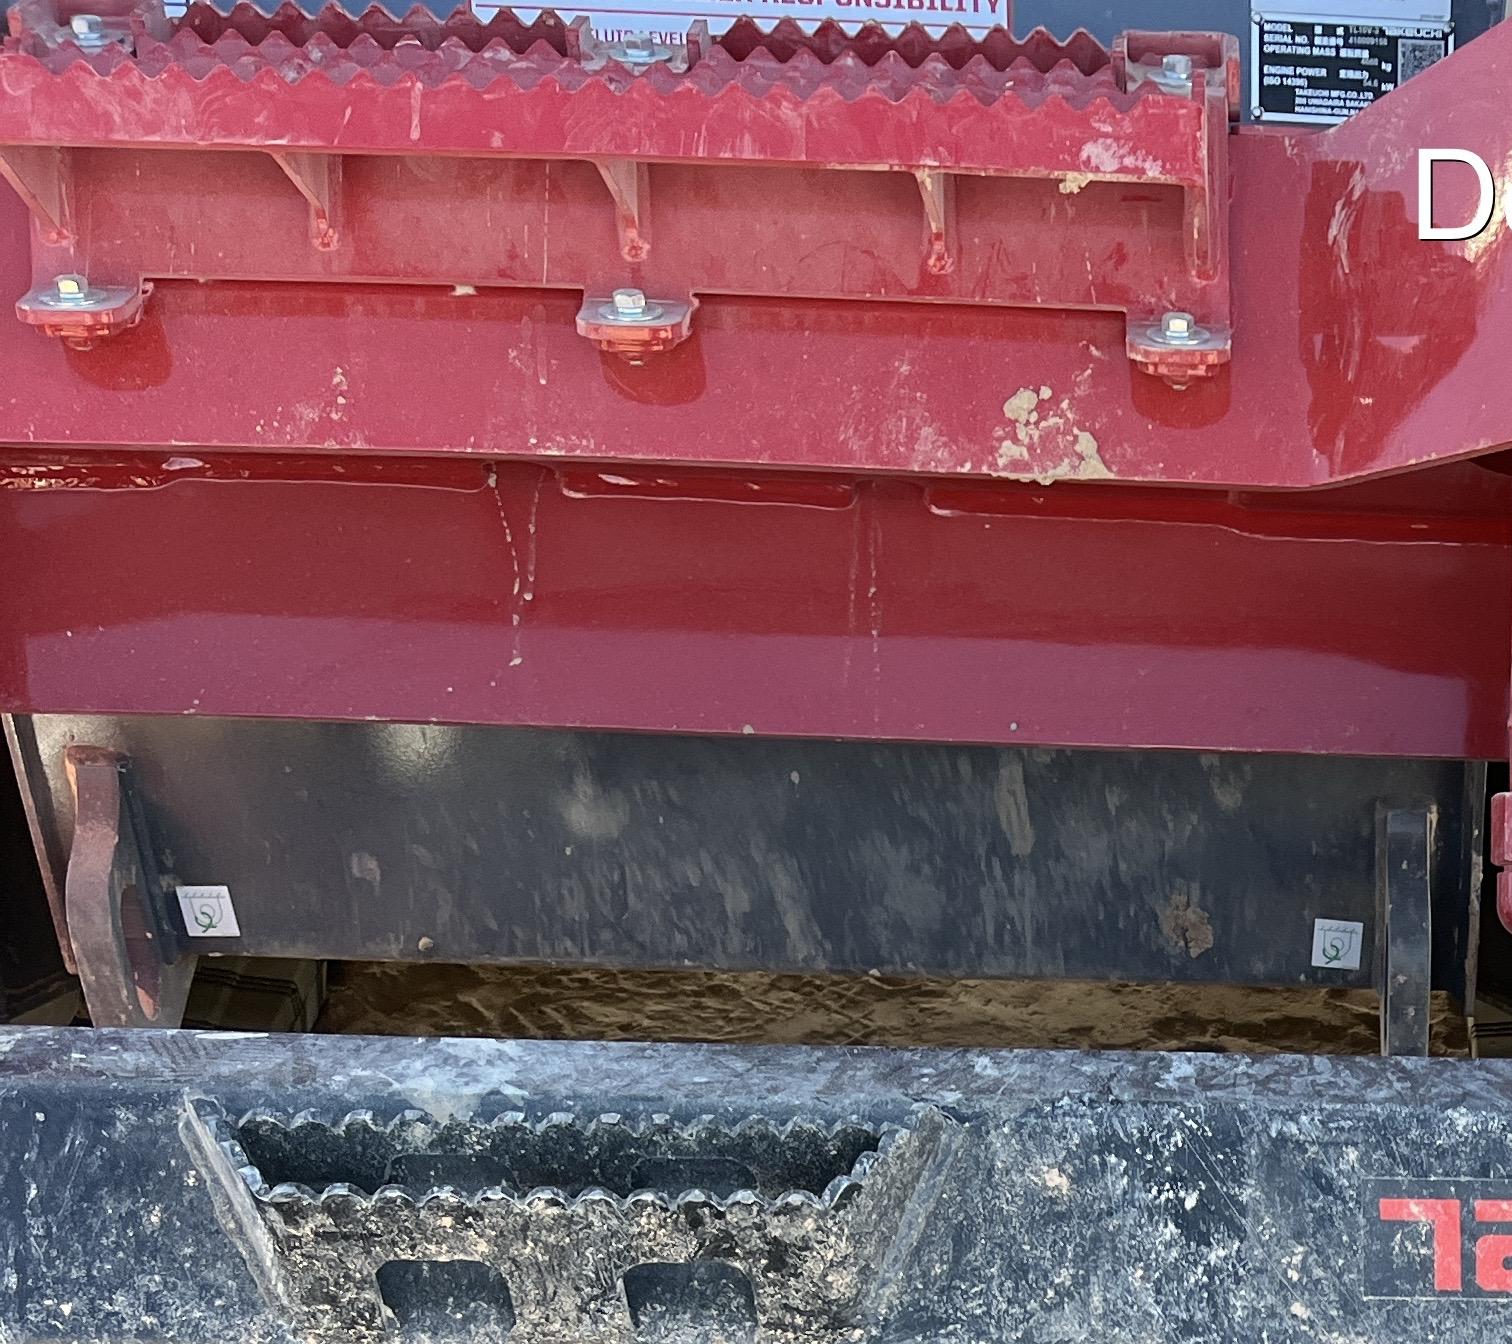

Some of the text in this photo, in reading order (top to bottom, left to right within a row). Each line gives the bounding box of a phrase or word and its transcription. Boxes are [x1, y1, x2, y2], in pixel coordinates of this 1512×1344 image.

[1263, 22, 1293, 33] MODEL
[1263, 43, 1311, 55] OPERATING
[1312, 46, 1336, 57] MASS
[1296, 67, 1327, 77] POWER
